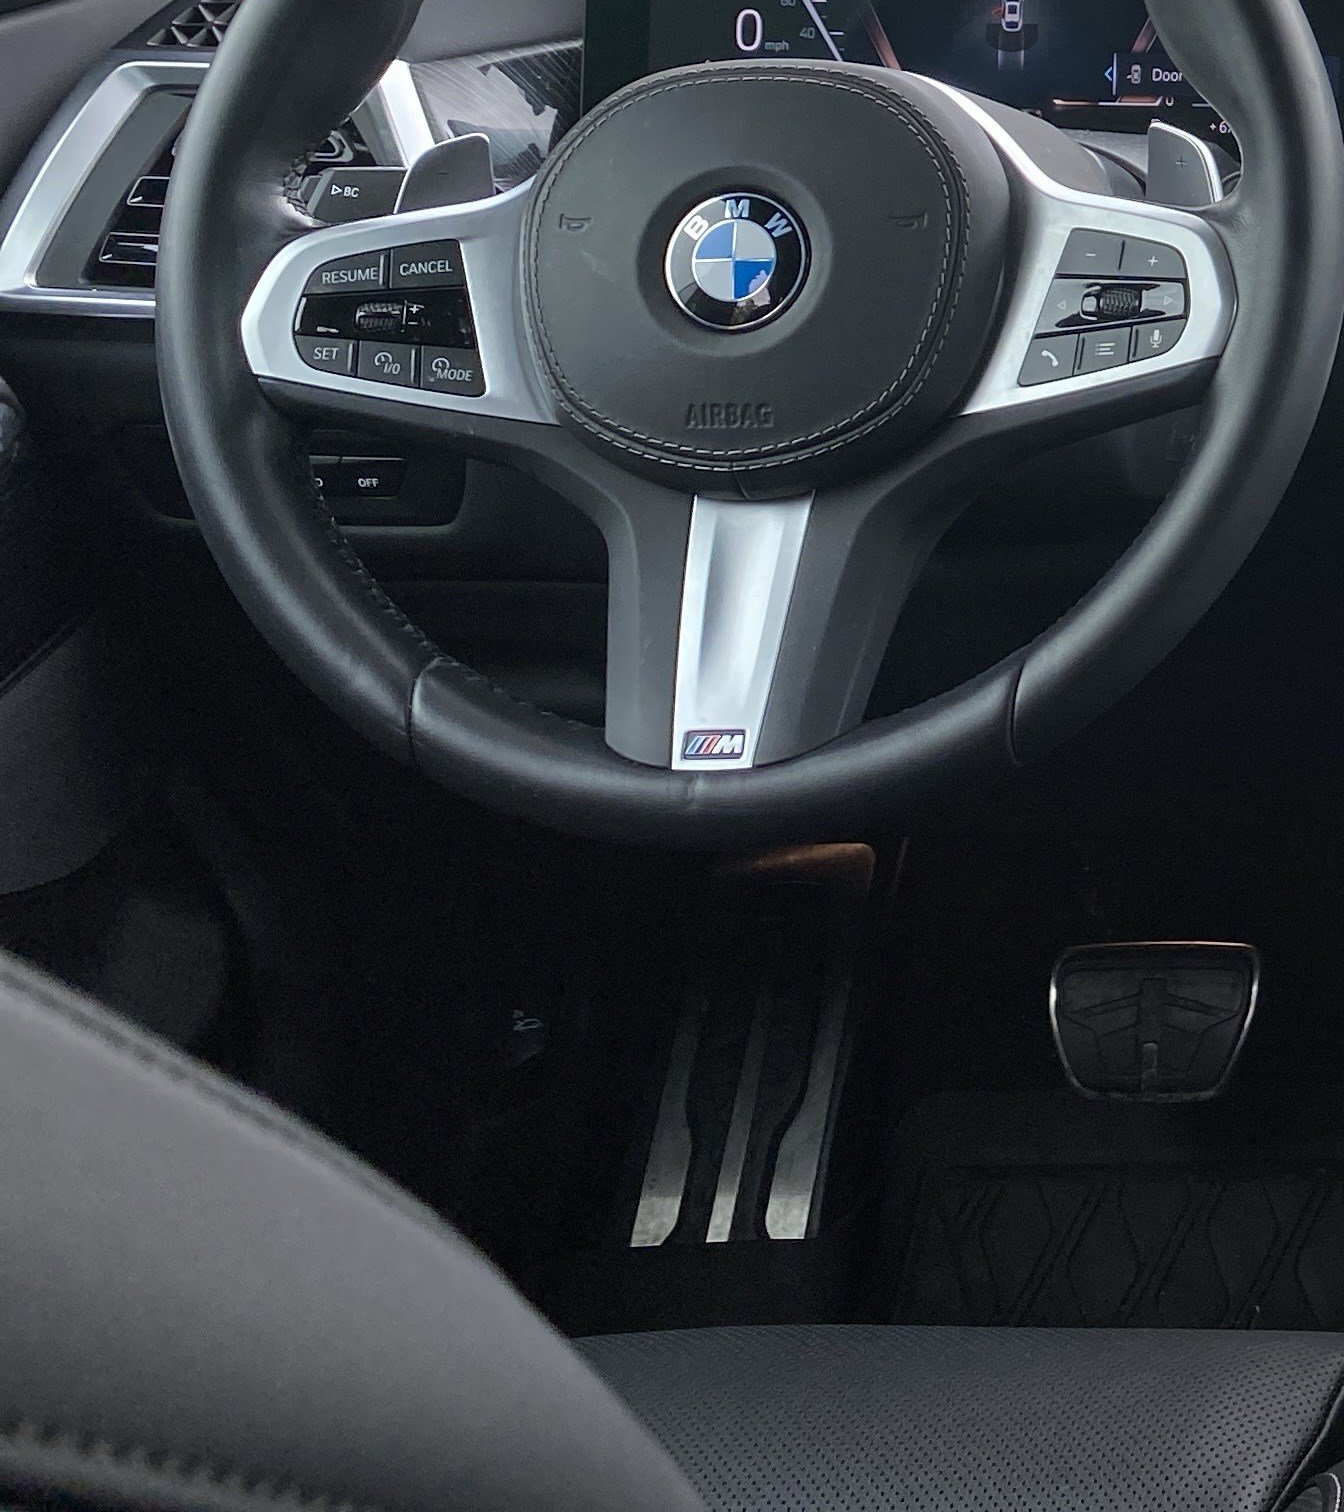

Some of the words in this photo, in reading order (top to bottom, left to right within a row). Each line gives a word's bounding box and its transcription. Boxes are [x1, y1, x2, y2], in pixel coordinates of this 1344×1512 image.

[735, 8, 763, 51] 0
[764, 40, 790, 52] mph
[799, 27, 816, 39] 40
[343, 186, 360, 198] BC
[683, 199, 793, 241] BMW
[399, 260, 453, 276] CANCEL
[321, 267, 378, 285] RESUME
[313, 347, 339, 360] SET
[436, 367, 473, 382] MODE
[685, 402, 774, 429] AIRBAG
[358, 478, 379, 487] OFF
